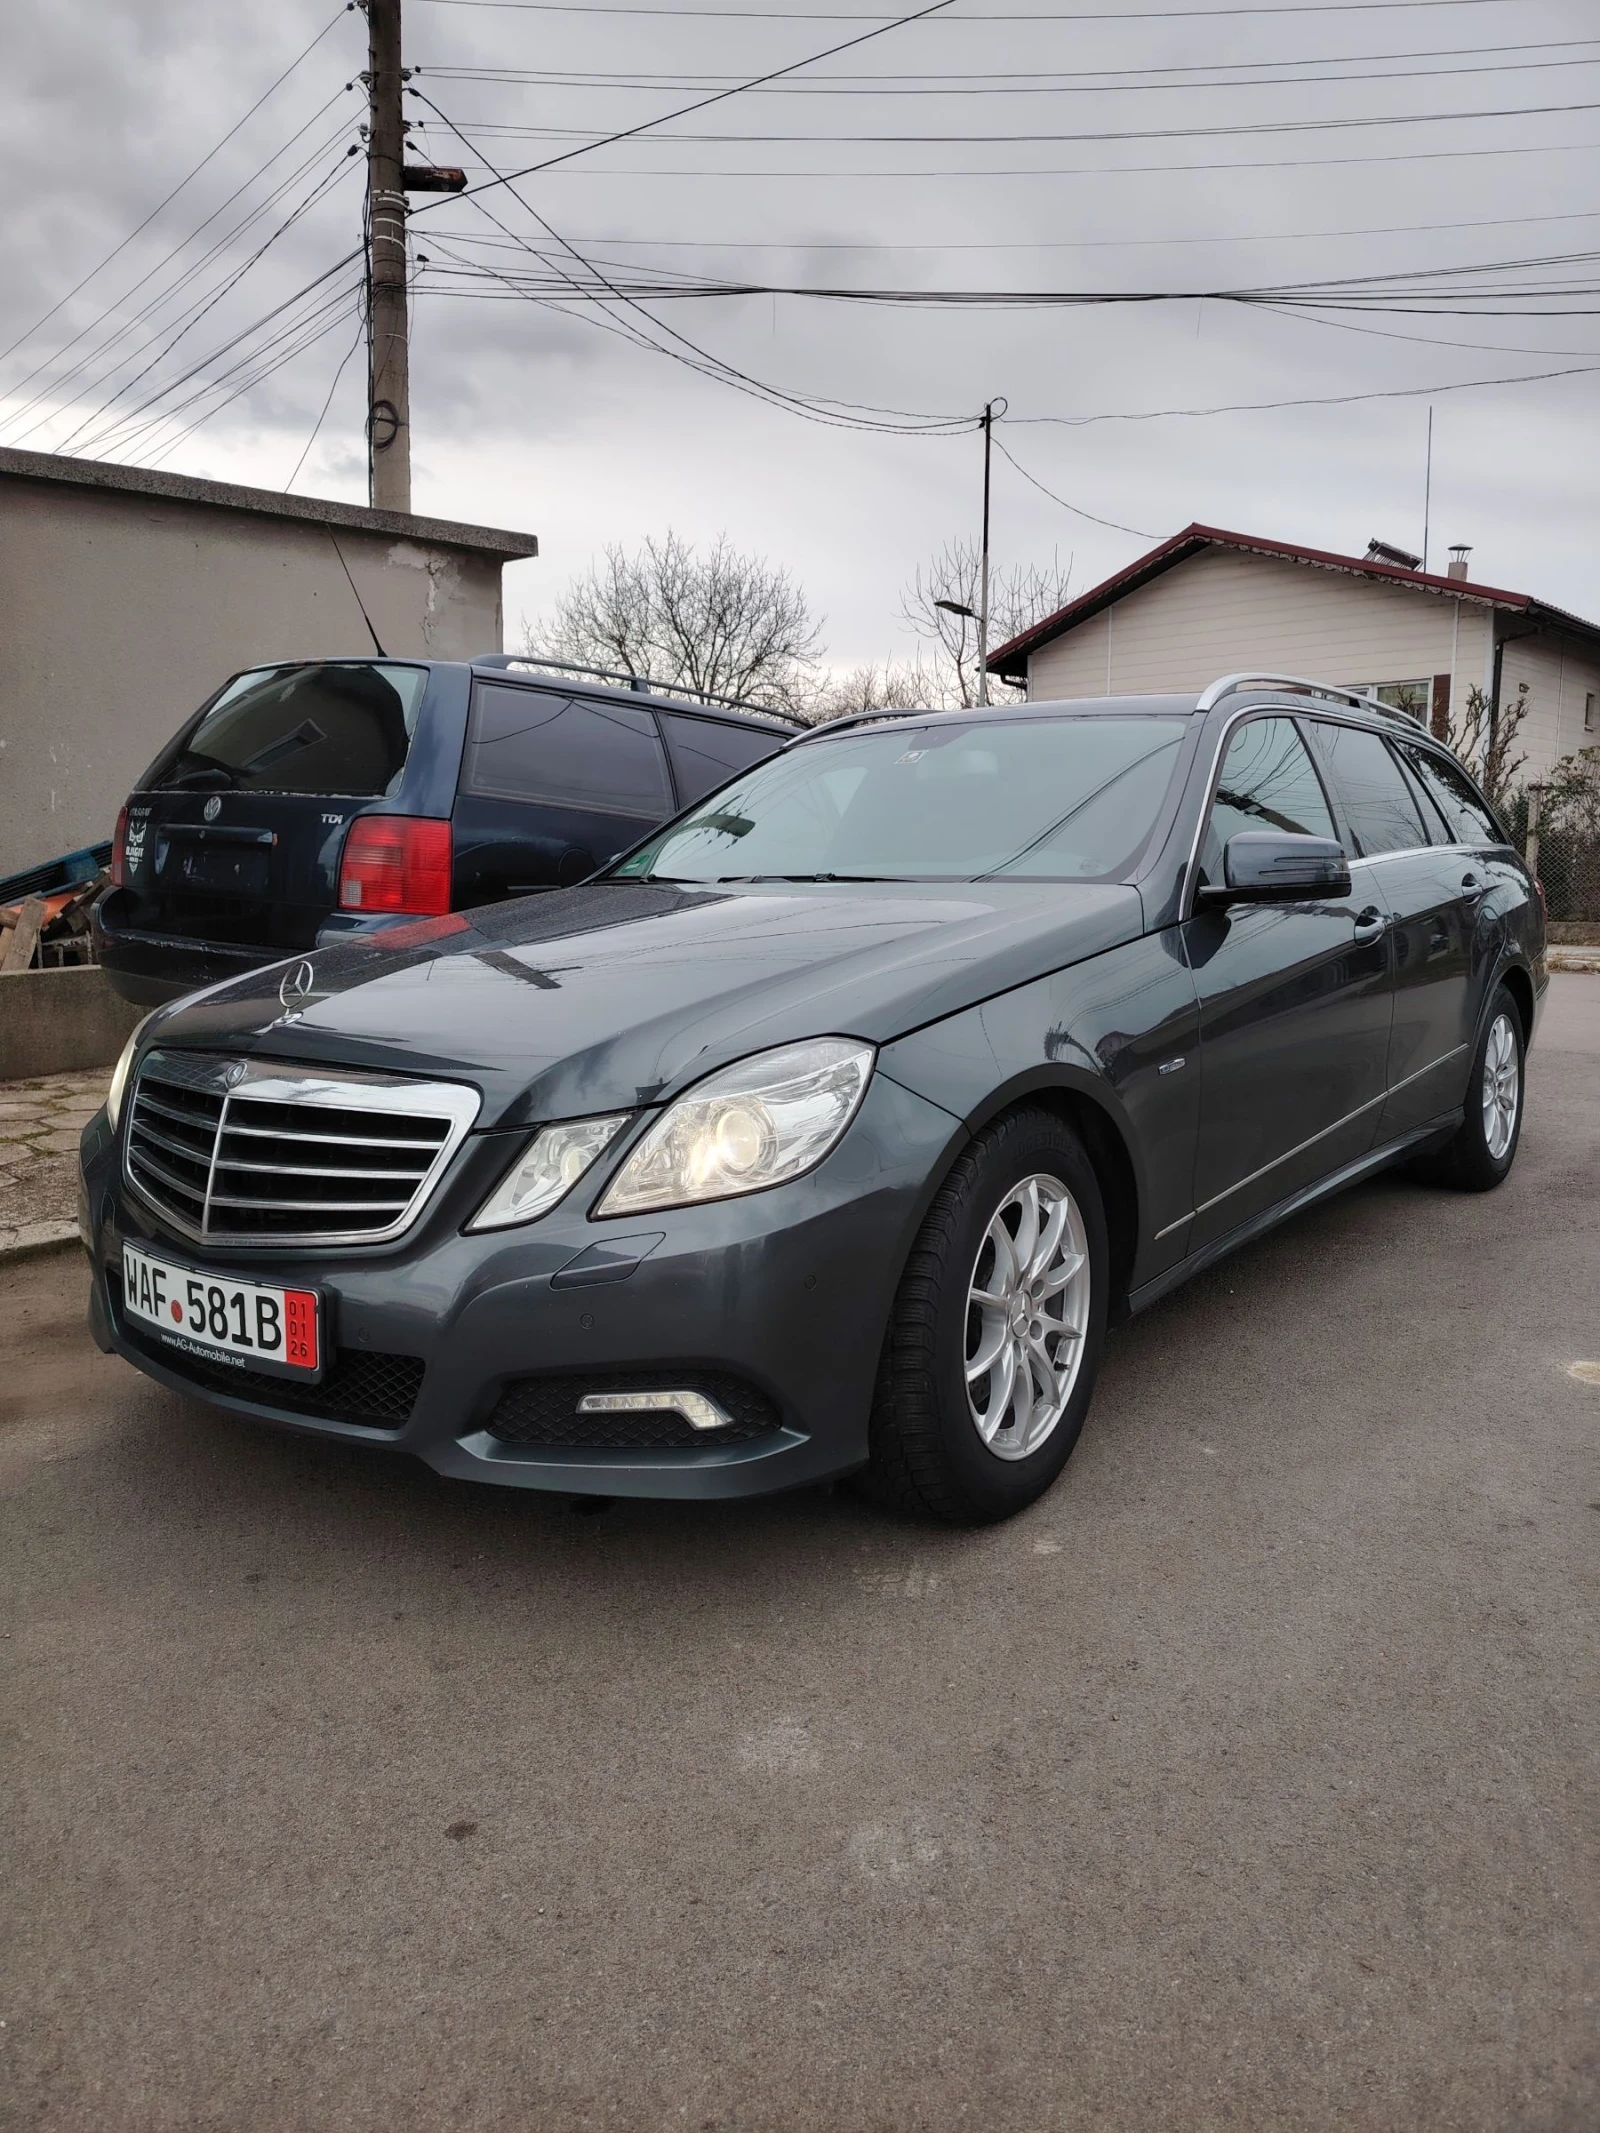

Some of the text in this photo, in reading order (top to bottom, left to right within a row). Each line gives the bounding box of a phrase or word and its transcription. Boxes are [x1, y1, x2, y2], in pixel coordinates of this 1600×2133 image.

[321, 813, 343, 825] TDI
[125, 1254, 282, 1351] WAF 581B
[290, 1301, 305, 1318] 01
[290, 1320, 306, 1338] 01
[161, 1333, 246, 1368] www.AG-Automobile.net
[291, 1340, 307, 1357] 26
